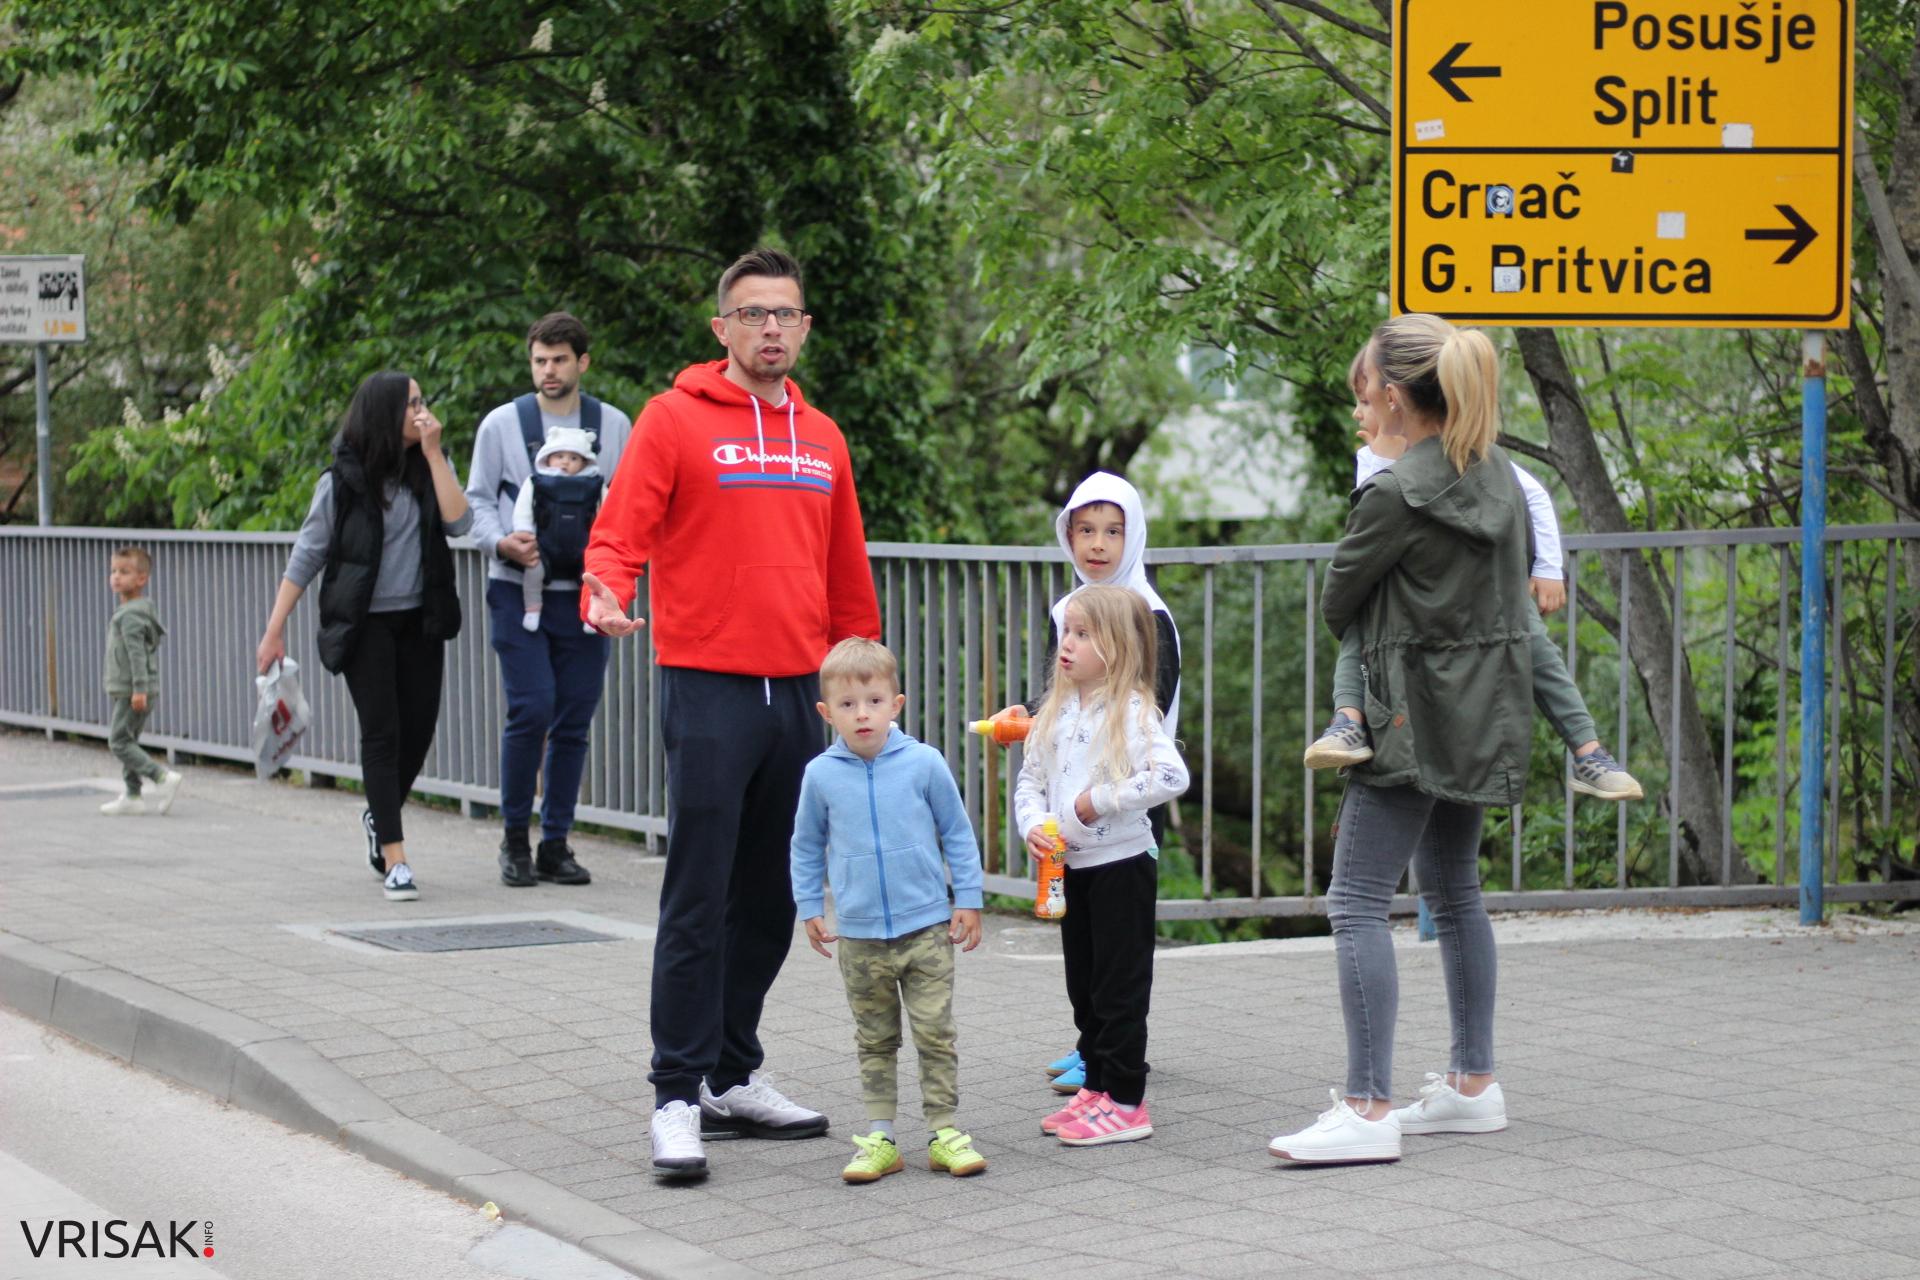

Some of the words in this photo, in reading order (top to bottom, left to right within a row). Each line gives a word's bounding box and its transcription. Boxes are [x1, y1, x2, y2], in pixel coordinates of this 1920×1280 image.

[1594, 1, 1816, 63] Posušje
[1593, 75, 1718, 138] Split
[1422, 243, 1472, 293] G.
[1491, 244, 1711, 294] Britvica
[713, 444, 832, 472] Champion
